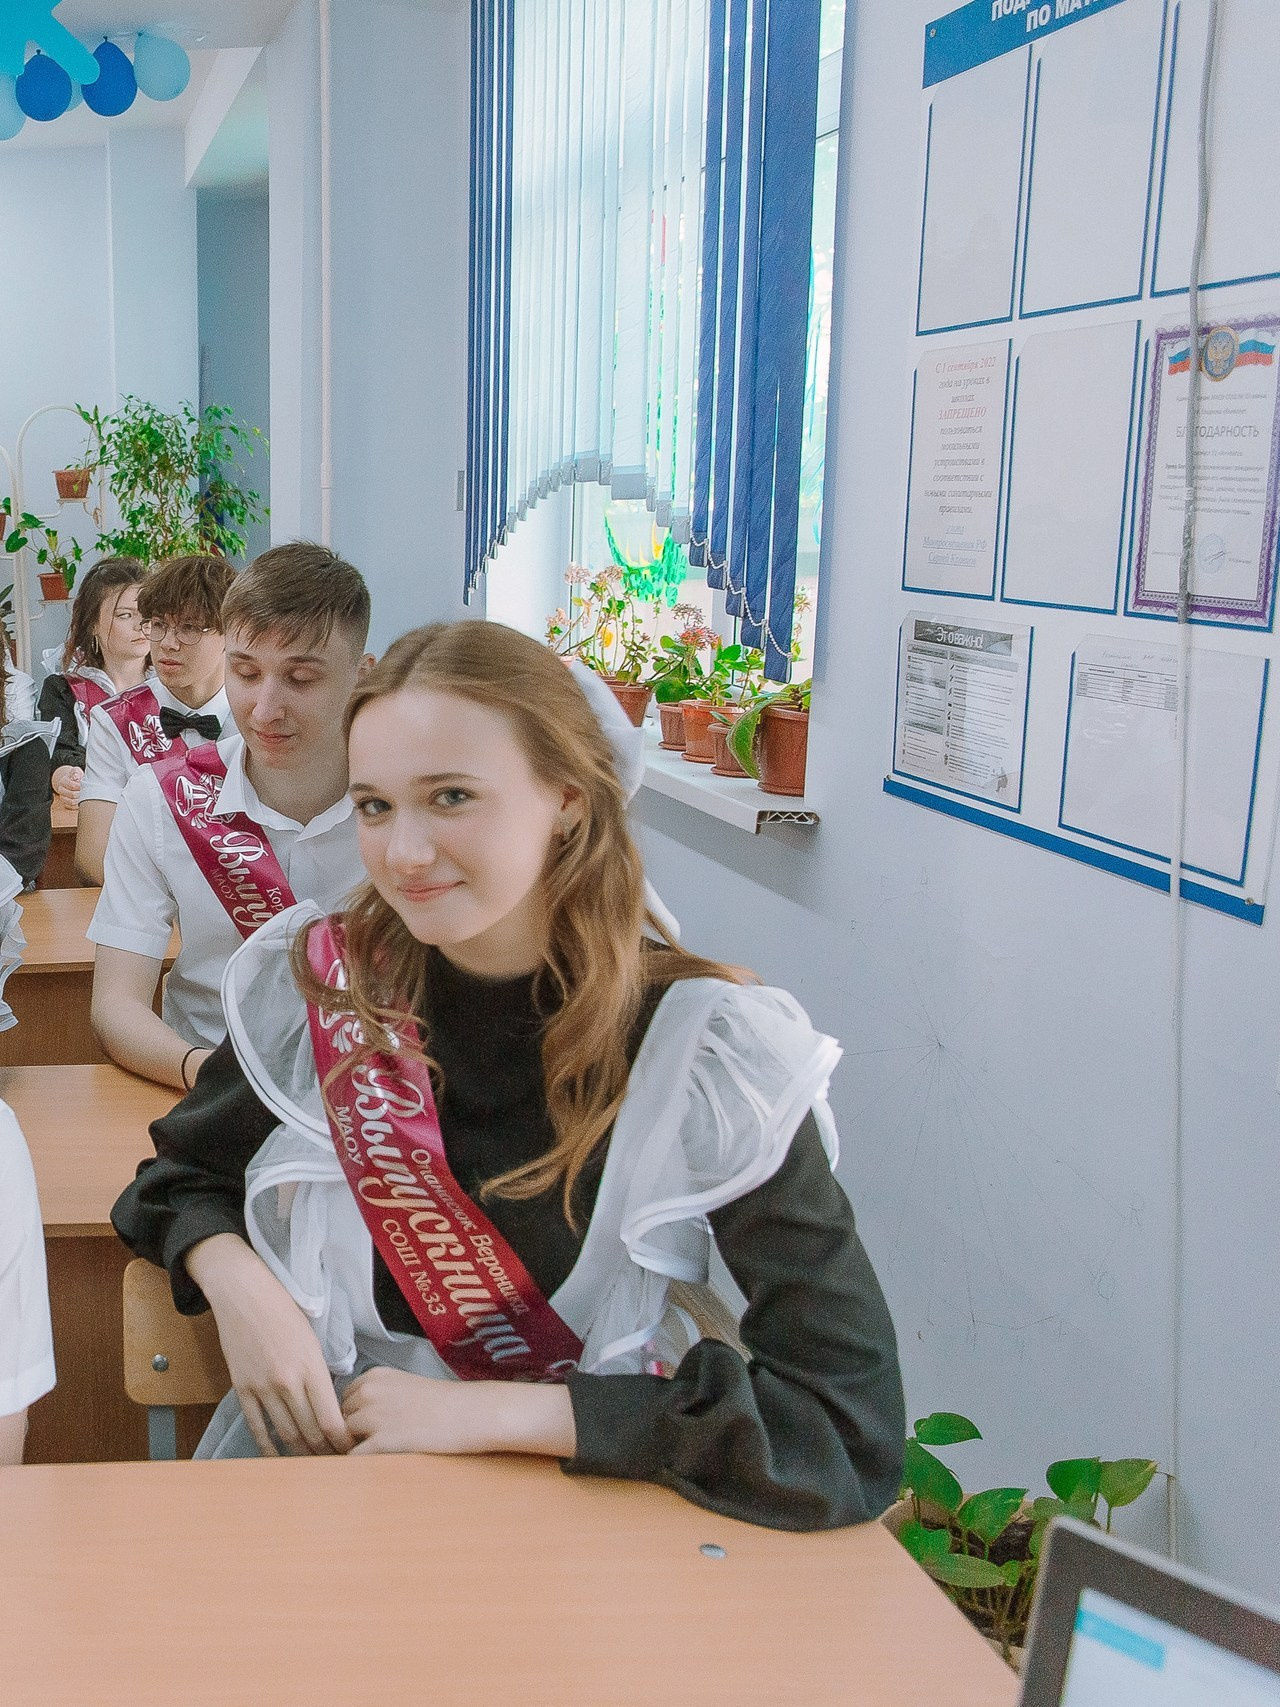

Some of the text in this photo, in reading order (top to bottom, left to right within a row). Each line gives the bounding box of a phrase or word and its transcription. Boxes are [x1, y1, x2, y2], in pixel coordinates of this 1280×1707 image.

[991, 0, 1031, 21] ПОД
[1026, 4, 1051, 32] ПО
[1176, 424, 1260, 438] БЛГОДАРНОСТЬ
[936, 626, 953, 644] Это
[335, 1106, 365, 1168] МАОУ
[382, 1219, 422, 1267] СОШ
[351, 1064, 532, 1362] Выпускница
[470, 1234, 531, 1316] Вероника
